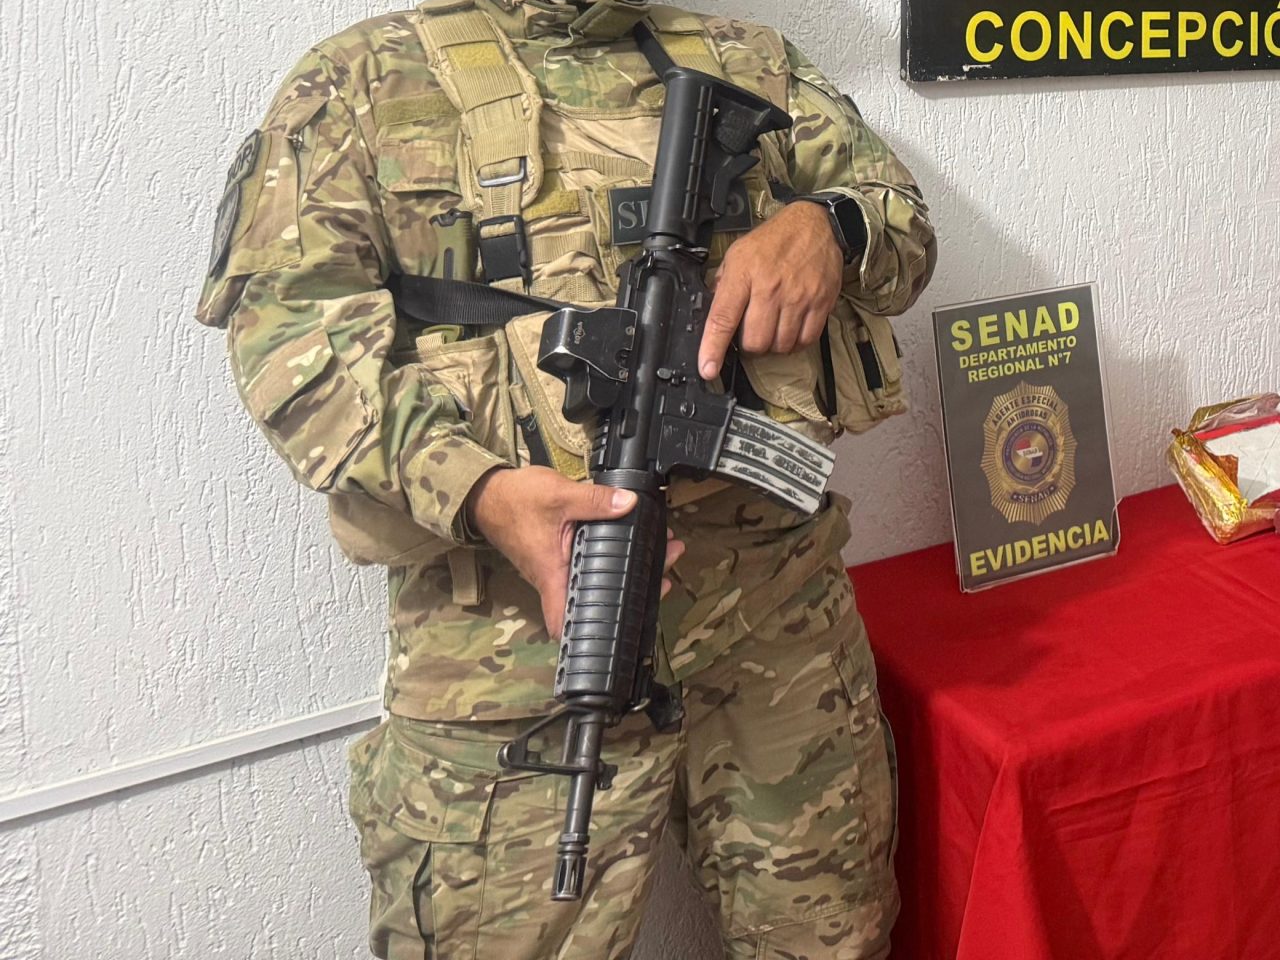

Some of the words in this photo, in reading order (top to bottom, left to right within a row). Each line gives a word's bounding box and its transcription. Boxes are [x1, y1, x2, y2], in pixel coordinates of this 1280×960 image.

[951, 301, 1079, 352] SENAD
[959, 335, 1077, 369] DEPARTAMENTO
[967, 357, 1044, 383] REGIONAL
[992, 399, 1019, 426] AGENTE
[1021, 395, 1058, 411] ESPECIAL
[1007, 409, 1048, 428] ANTIDROGAS
[969, 519, 1110, 577] EVIDENCIA
